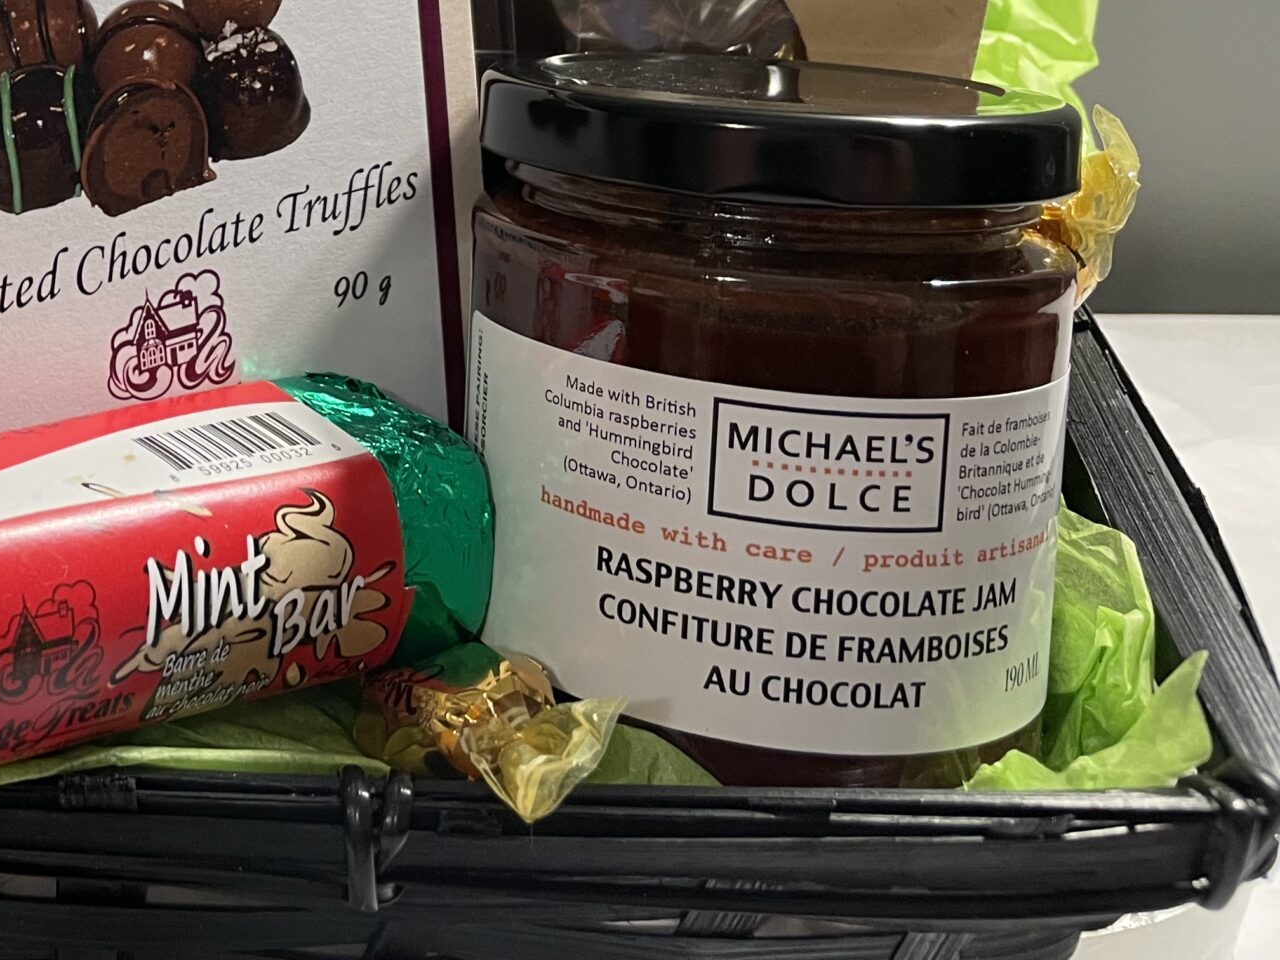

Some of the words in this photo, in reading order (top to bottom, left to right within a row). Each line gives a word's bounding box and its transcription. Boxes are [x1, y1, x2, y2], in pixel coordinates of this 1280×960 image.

[76, 207, 264, 296] Chocolate
[276, 160, 419, 237] Truffles
[334, 271, 369, 308] 90
[379, 274, 393, 307] g
[545, 390, 604, 420] Columbia
[609, 411, 697, 440] raspberries
[566, 374, 603, 398] Made
[608, 387, 641, 407] with
[645, 396, 696, 418] British
[558, 415, 581, 434] and
[586, 421, 693, 460] 'Hummingbird
[727, 422, 935, 464] MICHAEL'S
[962, 421, 984, 437] Fait
[987, 419, 1002, 435] de
[1005, 410, 1050, 433] framboises
[198, 458, 253, 477] 59925
[260, 446, 313, 464] 00032
[611, 450, 694, 480] Chocolate'
[959, 460, 1024, 479] Britannique
[1025, 456, 1034, 468] et
[1036, 452, 1045, 464] de
[960, 443, 976, 458] de
[980, 442, 990, 457] la
[993, 433, 1041, 455] Colombie-
[563, 455, 621, 488] (Ottawa,
[626, 475, 692, 505] Ontario)
[748, 473, 912, 513] DOLCE
[958, 481, 1011, 500] 'Chocolat
[540, 485, 646, 535] handmade
[660, 525, 728, 553] with
[745, 542, 813, 565] care
[831, 546, 846, 567] /
[862, 544, 965, 573] produit
[977, 530, 1049, 563] artisana
[956, 505, 985, 522] bird'
[987, 500, 1029, 522] (Ottawa,
[145, 533, 270, 649] Mint
[596, 545, 784, 610] RASPBERRY
[791, 585, 966, 619] CHOCOLATE
[972, 577, 1017, 612] JAM
[271, 571, 366, 657] Bar
[598, 592, 774, 656] CONFITURE
[785, 630, 827, 662] DE
[837, 623, 1009, 665] FRAMBOISES
[163, 646, 208, 677] Barre
[210, 640, 231, 663] de
[1004, 661, 1024, 693] 190
[1025, 651, 1040, 683] ML
[145, 702, 166, 720] au
[170, 684, 234, 716] chocolat
[235, 672, 271, 698] noir
[156, 670, 215, 699] menthe
[703, 664, 751, 698] AU
[761, 674, 927, 710] CHOCOLAT
[22, 690, 135, 750] Treats
